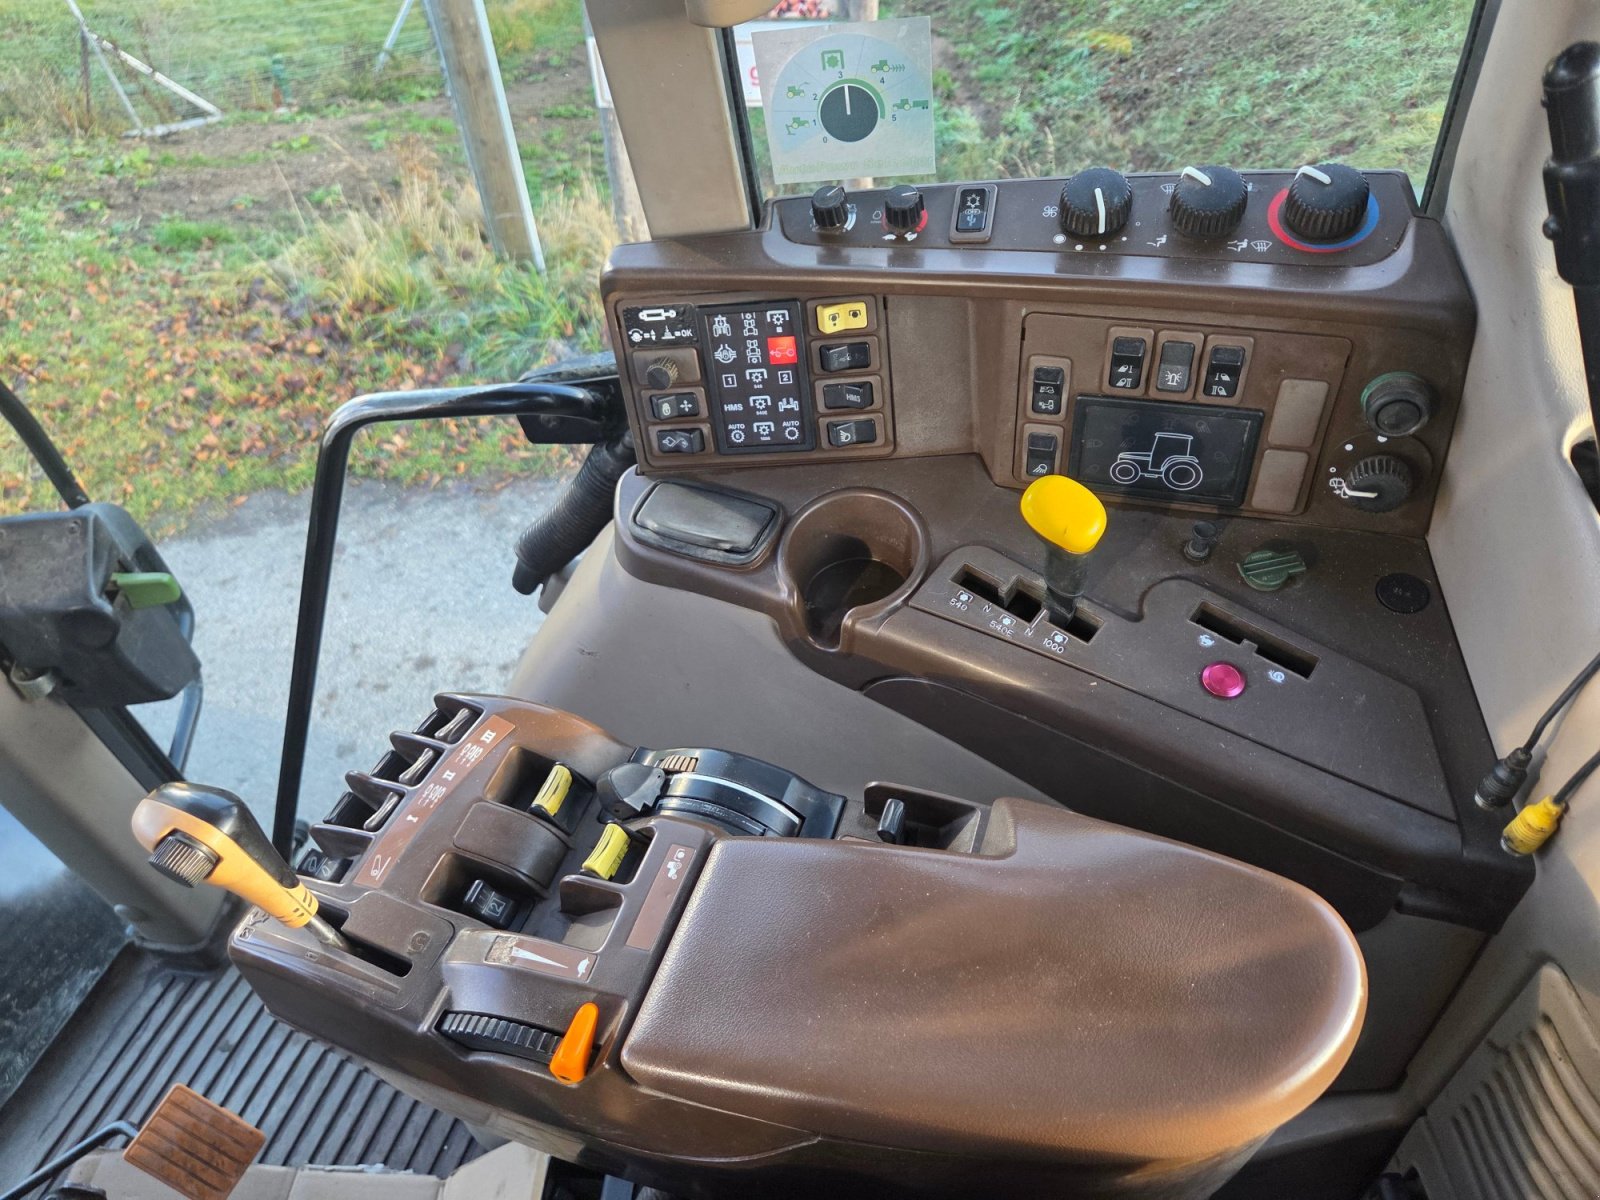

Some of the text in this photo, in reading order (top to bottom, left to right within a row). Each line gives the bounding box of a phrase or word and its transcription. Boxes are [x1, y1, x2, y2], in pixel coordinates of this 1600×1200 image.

[724, 404, 744, 412] HMS
[949, 598, 968, 611] 540
[989, 620, 1014, 637] 540E
[1042, 638, 1065, 654] 1000
